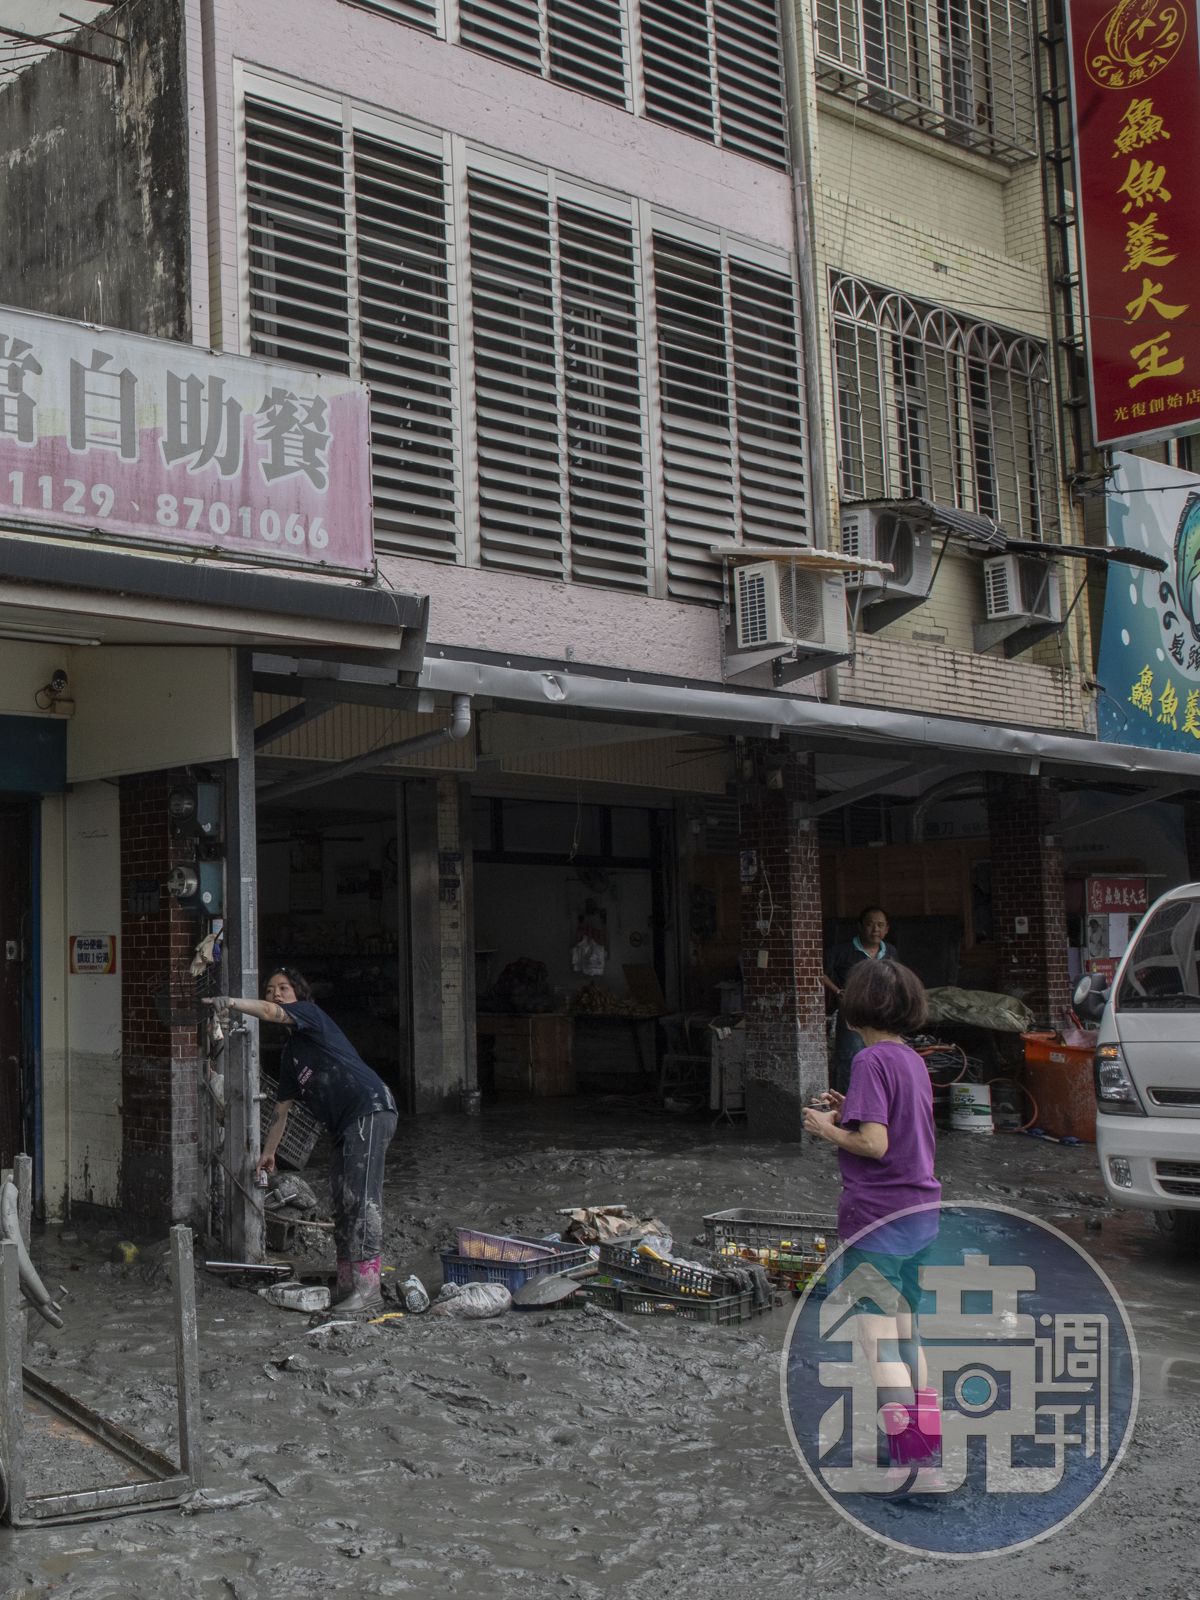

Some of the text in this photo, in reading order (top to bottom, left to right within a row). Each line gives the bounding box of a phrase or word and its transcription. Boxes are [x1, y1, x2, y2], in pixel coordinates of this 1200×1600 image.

[1112, 98, 1190, 389] 鱻魚羹大王
[1113, 388, 1200, 422] 光復創始店
[156, 493, 329, 549] 8701066
